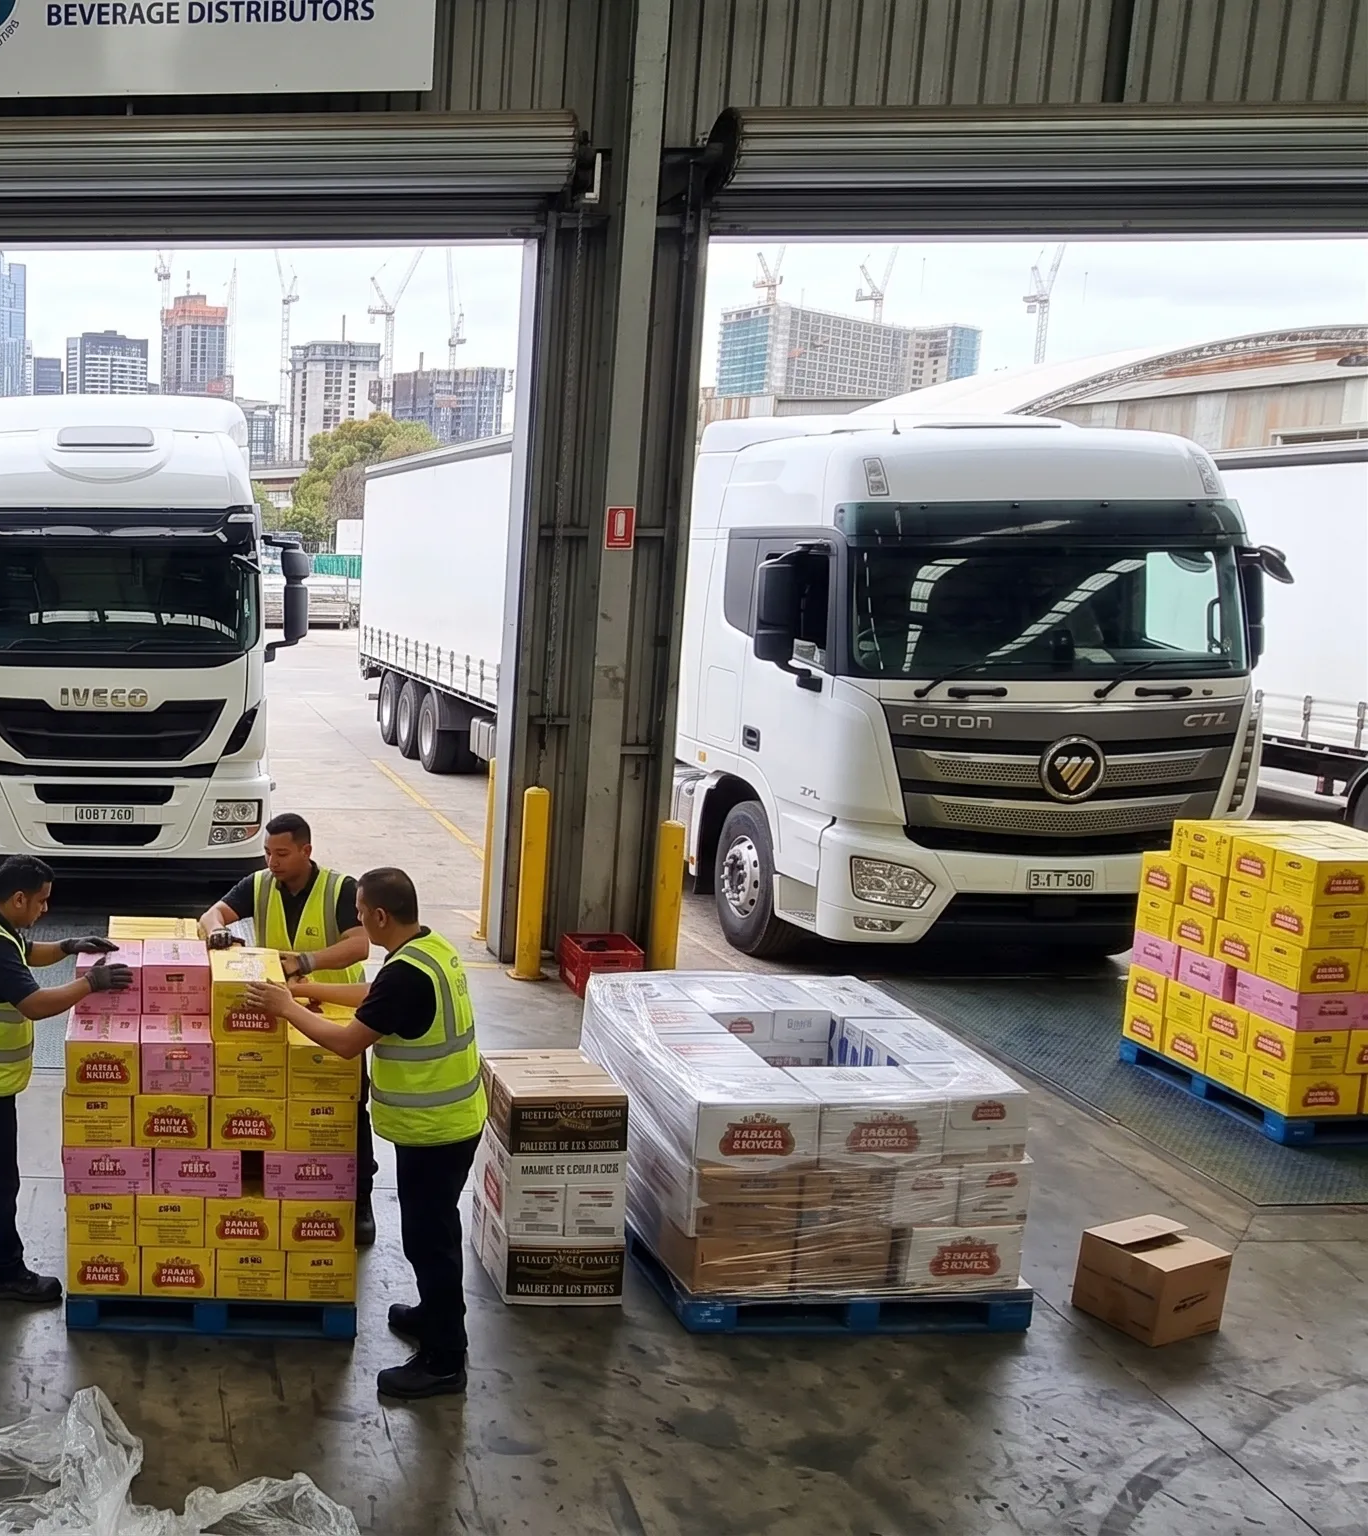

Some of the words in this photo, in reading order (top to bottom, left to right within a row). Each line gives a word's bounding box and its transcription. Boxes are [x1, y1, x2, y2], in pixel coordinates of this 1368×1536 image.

[46, 3, 180, 26] BEVERAGE
[187, 0, 375, 24] DISTRIBUTORS
[60, 687, 148, 708] IVECO
[901, 713, 993, 729] FOTON
[1183, 712, 1230, 727] CTL
